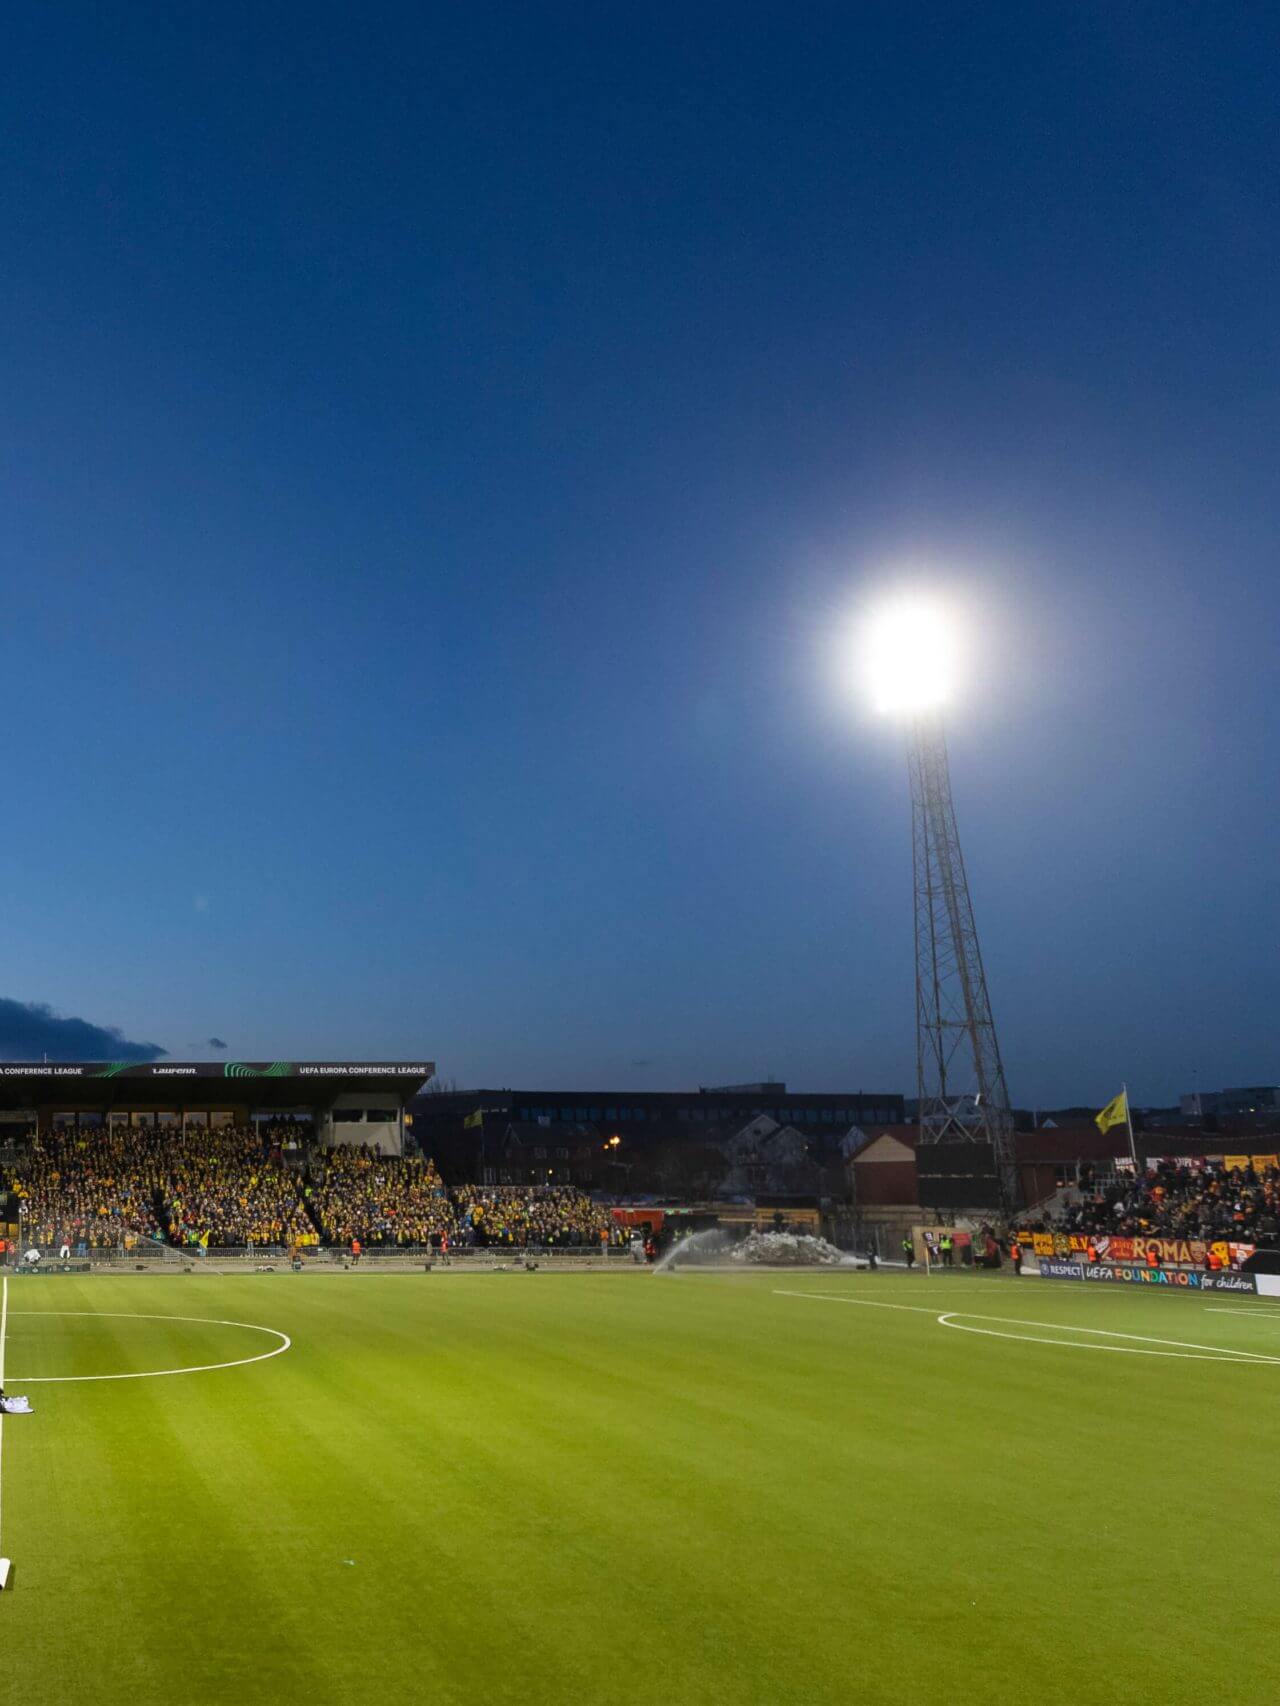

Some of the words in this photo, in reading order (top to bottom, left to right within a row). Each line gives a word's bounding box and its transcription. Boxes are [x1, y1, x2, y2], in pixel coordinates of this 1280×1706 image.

[4, 1067, 52, 1075] CONFERENCE
[54, 1067, 82, 1075] LEAGUE
[299, 1066, 319, 1074] UEFA
[320, 1066, 348, 1074] EUROPA
[348, 1066, 396, 1074] CONFERENCE
[397, 1066, 426, 1074] LEAGUE
[1133, 1237, 1192, 1262] ROMA
[1050, 1265, 1081, 1276] RESPECT
[1086, 1267, 1113, 1279] UEFA
[1201, 1274, 1213, 1290] for
[1216, 1276, 1253, 1290] children
